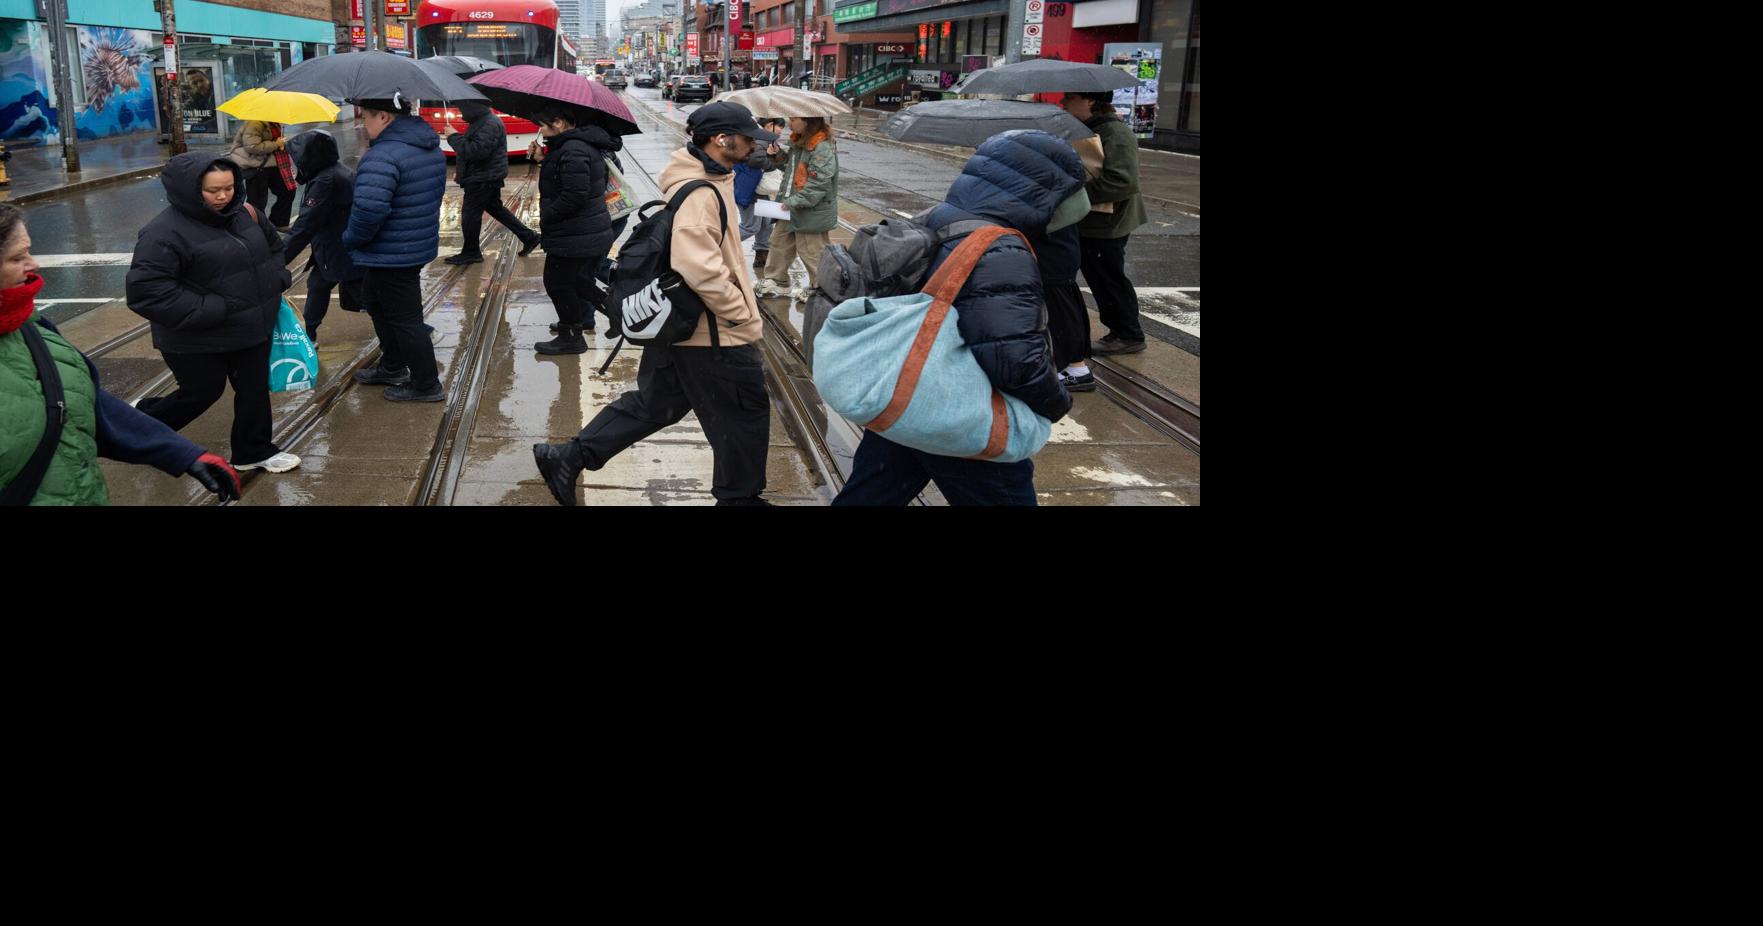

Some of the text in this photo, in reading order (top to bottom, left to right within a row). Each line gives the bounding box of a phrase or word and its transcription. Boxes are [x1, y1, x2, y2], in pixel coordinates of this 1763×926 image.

[469, 11, 494, 19] 4629
[729, 0, 739, 20] CIBC
[622, 277, 667, 327] NIKE
